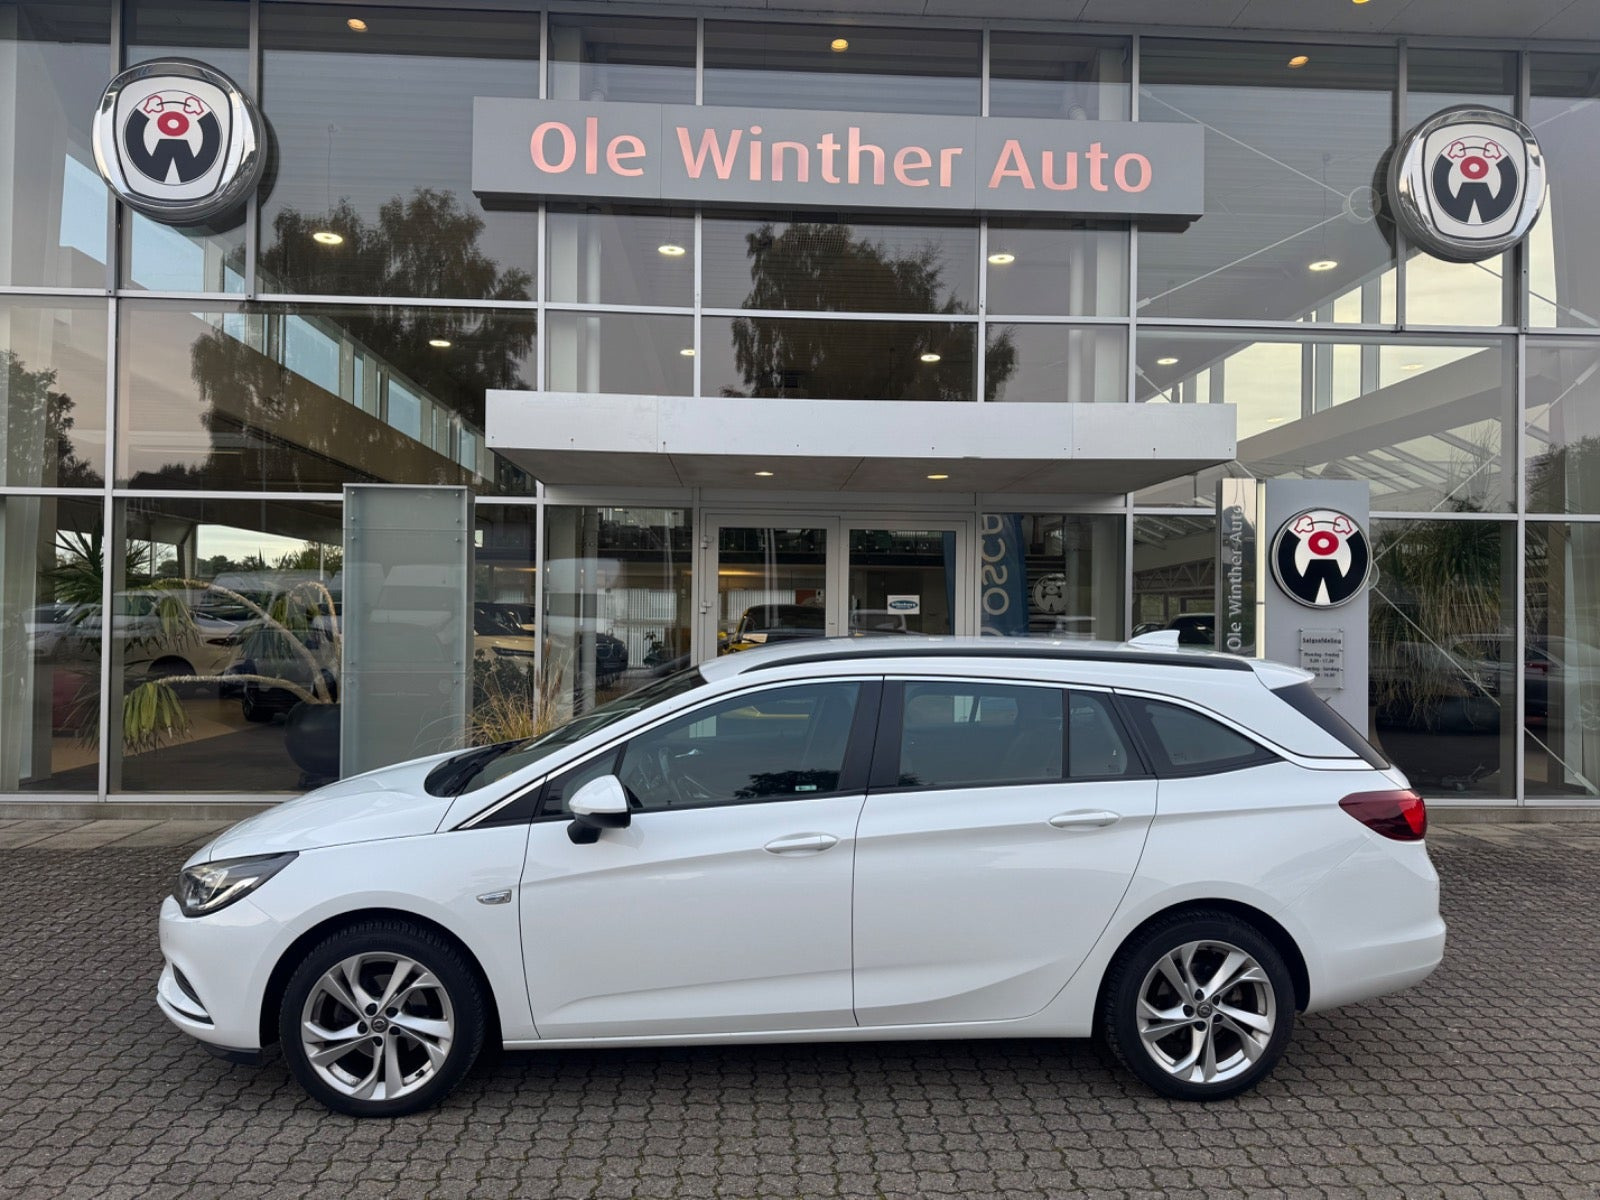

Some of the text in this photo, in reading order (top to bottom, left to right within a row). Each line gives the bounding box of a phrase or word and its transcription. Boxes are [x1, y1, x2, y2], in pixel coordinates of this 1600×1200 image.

[530, 116, 1152, 193] Ole Winther Auto
[1226, 504, 1243, 650] Ole Winther Auto
